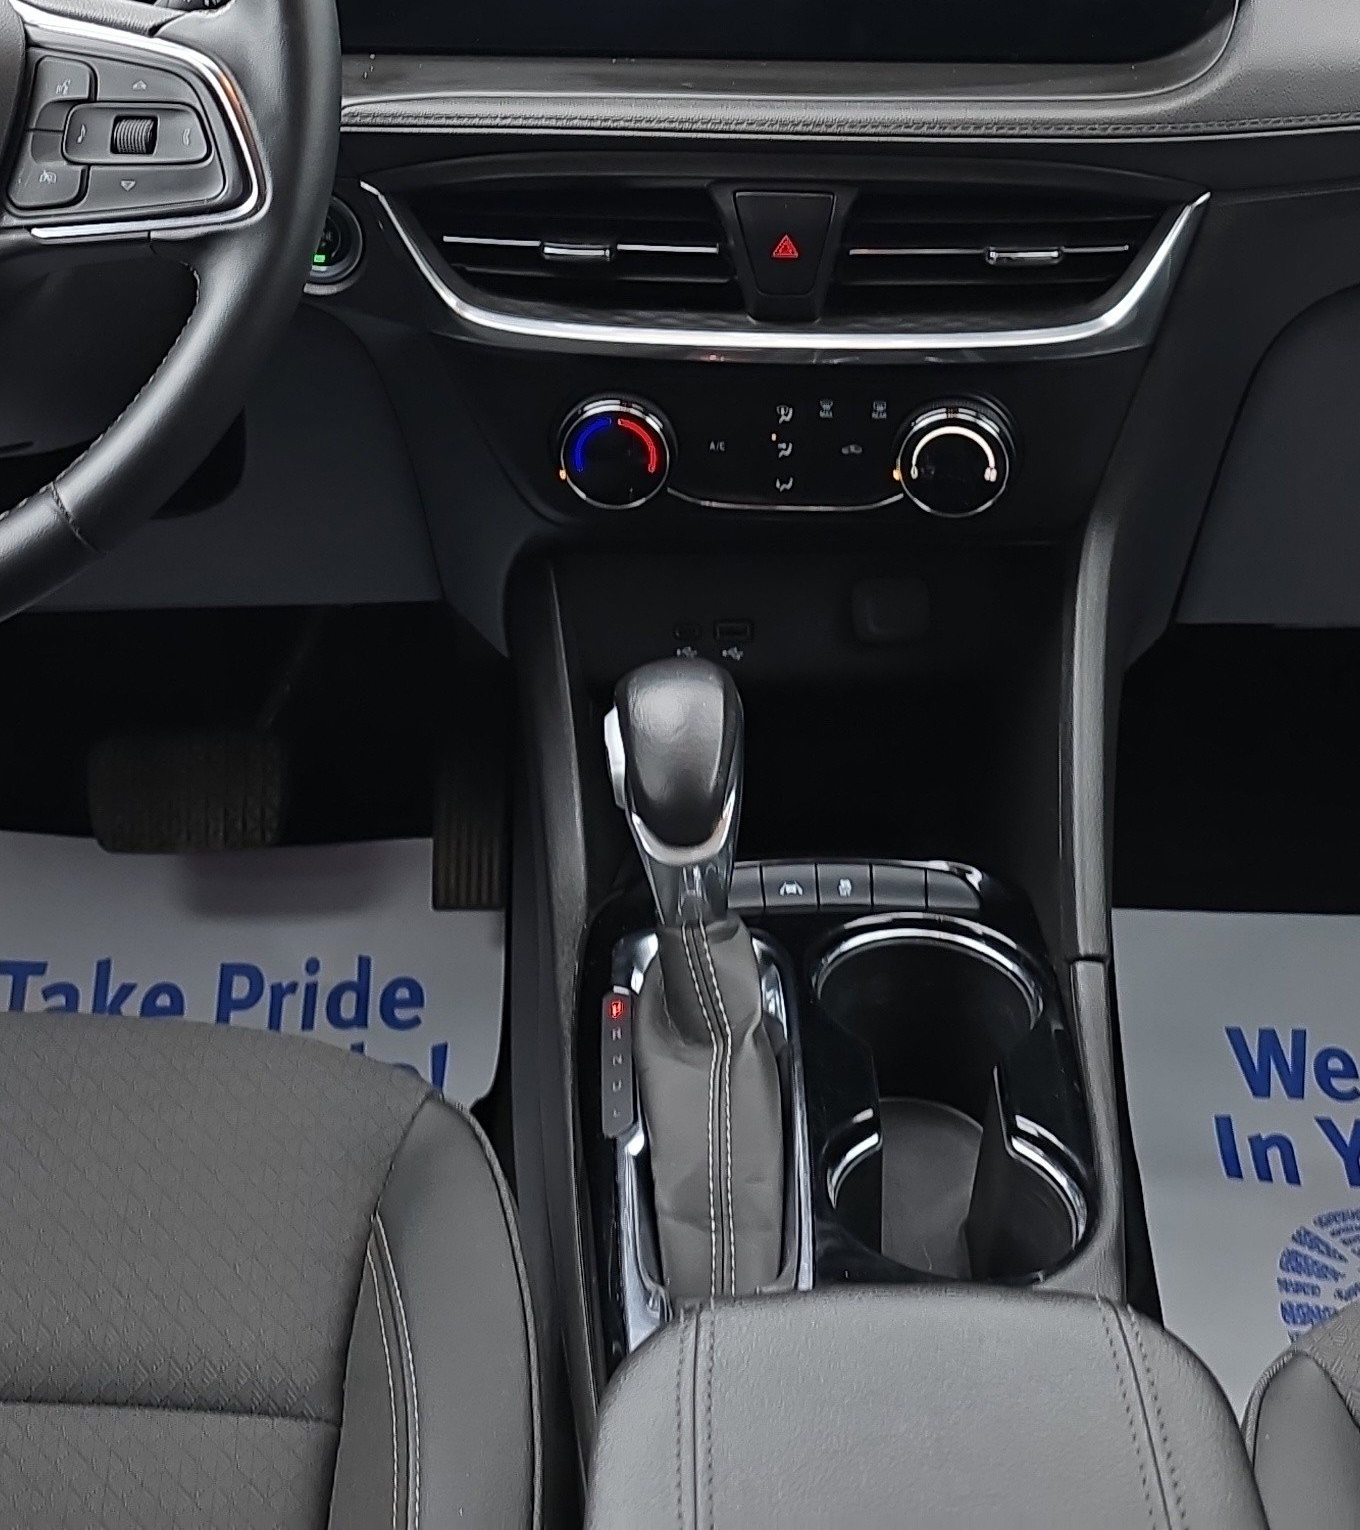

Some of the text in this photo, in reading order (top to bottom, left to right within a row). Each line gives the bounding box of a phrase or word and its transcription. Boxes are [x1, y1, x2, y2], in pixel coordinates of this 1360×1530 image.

[709, 440, 726, 451] A/C
[215, 954, 428, 1032] Pride
[1224, 1025, 1360, 1102] We
[1213, 1113, 1301, 1187] In
